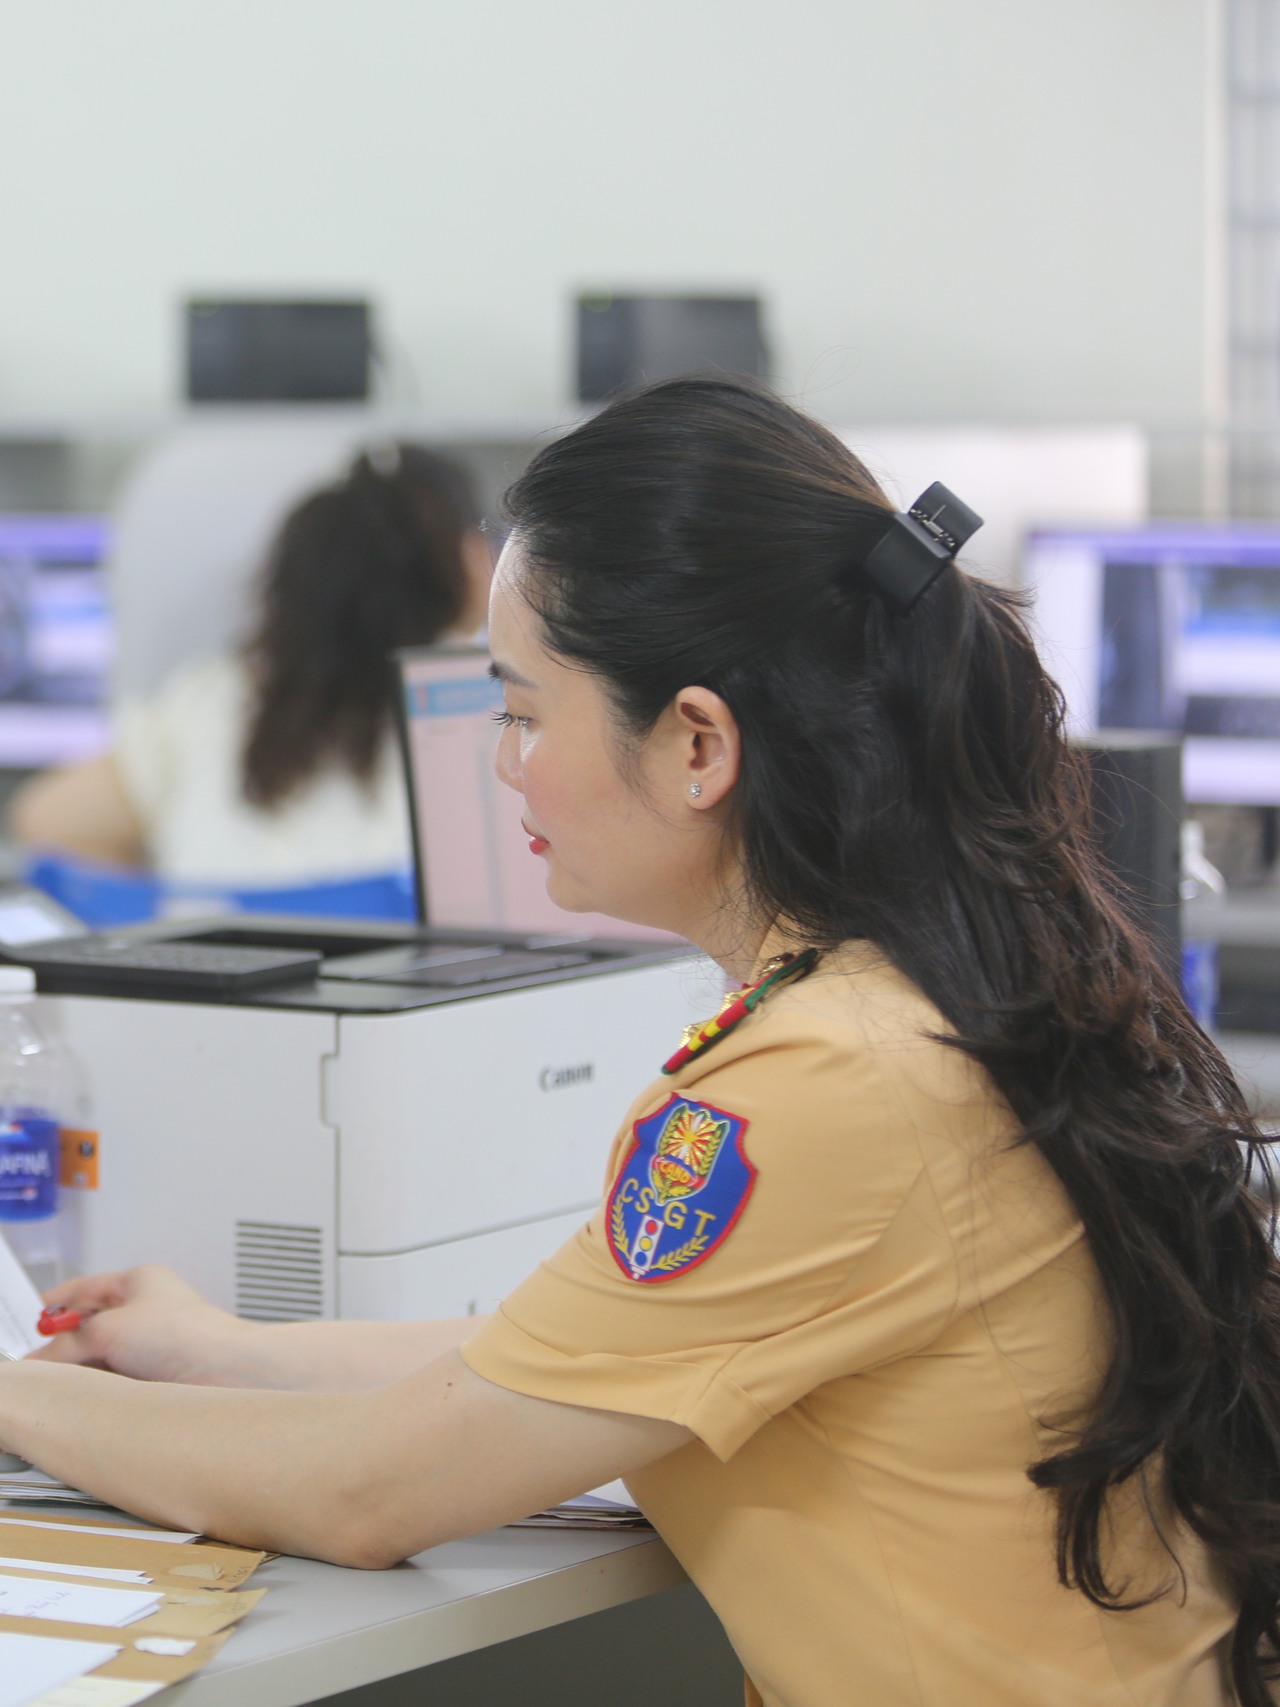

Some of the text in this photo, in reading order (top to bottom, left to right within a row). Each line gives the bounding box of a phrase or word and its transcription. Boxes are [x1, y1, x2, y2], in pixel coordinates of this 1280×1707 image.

[539, 1062, 595, 1092] Canon
[660, 1161, 691, 1184] CAND
[621, 1178, 716, 1237] CSGT
